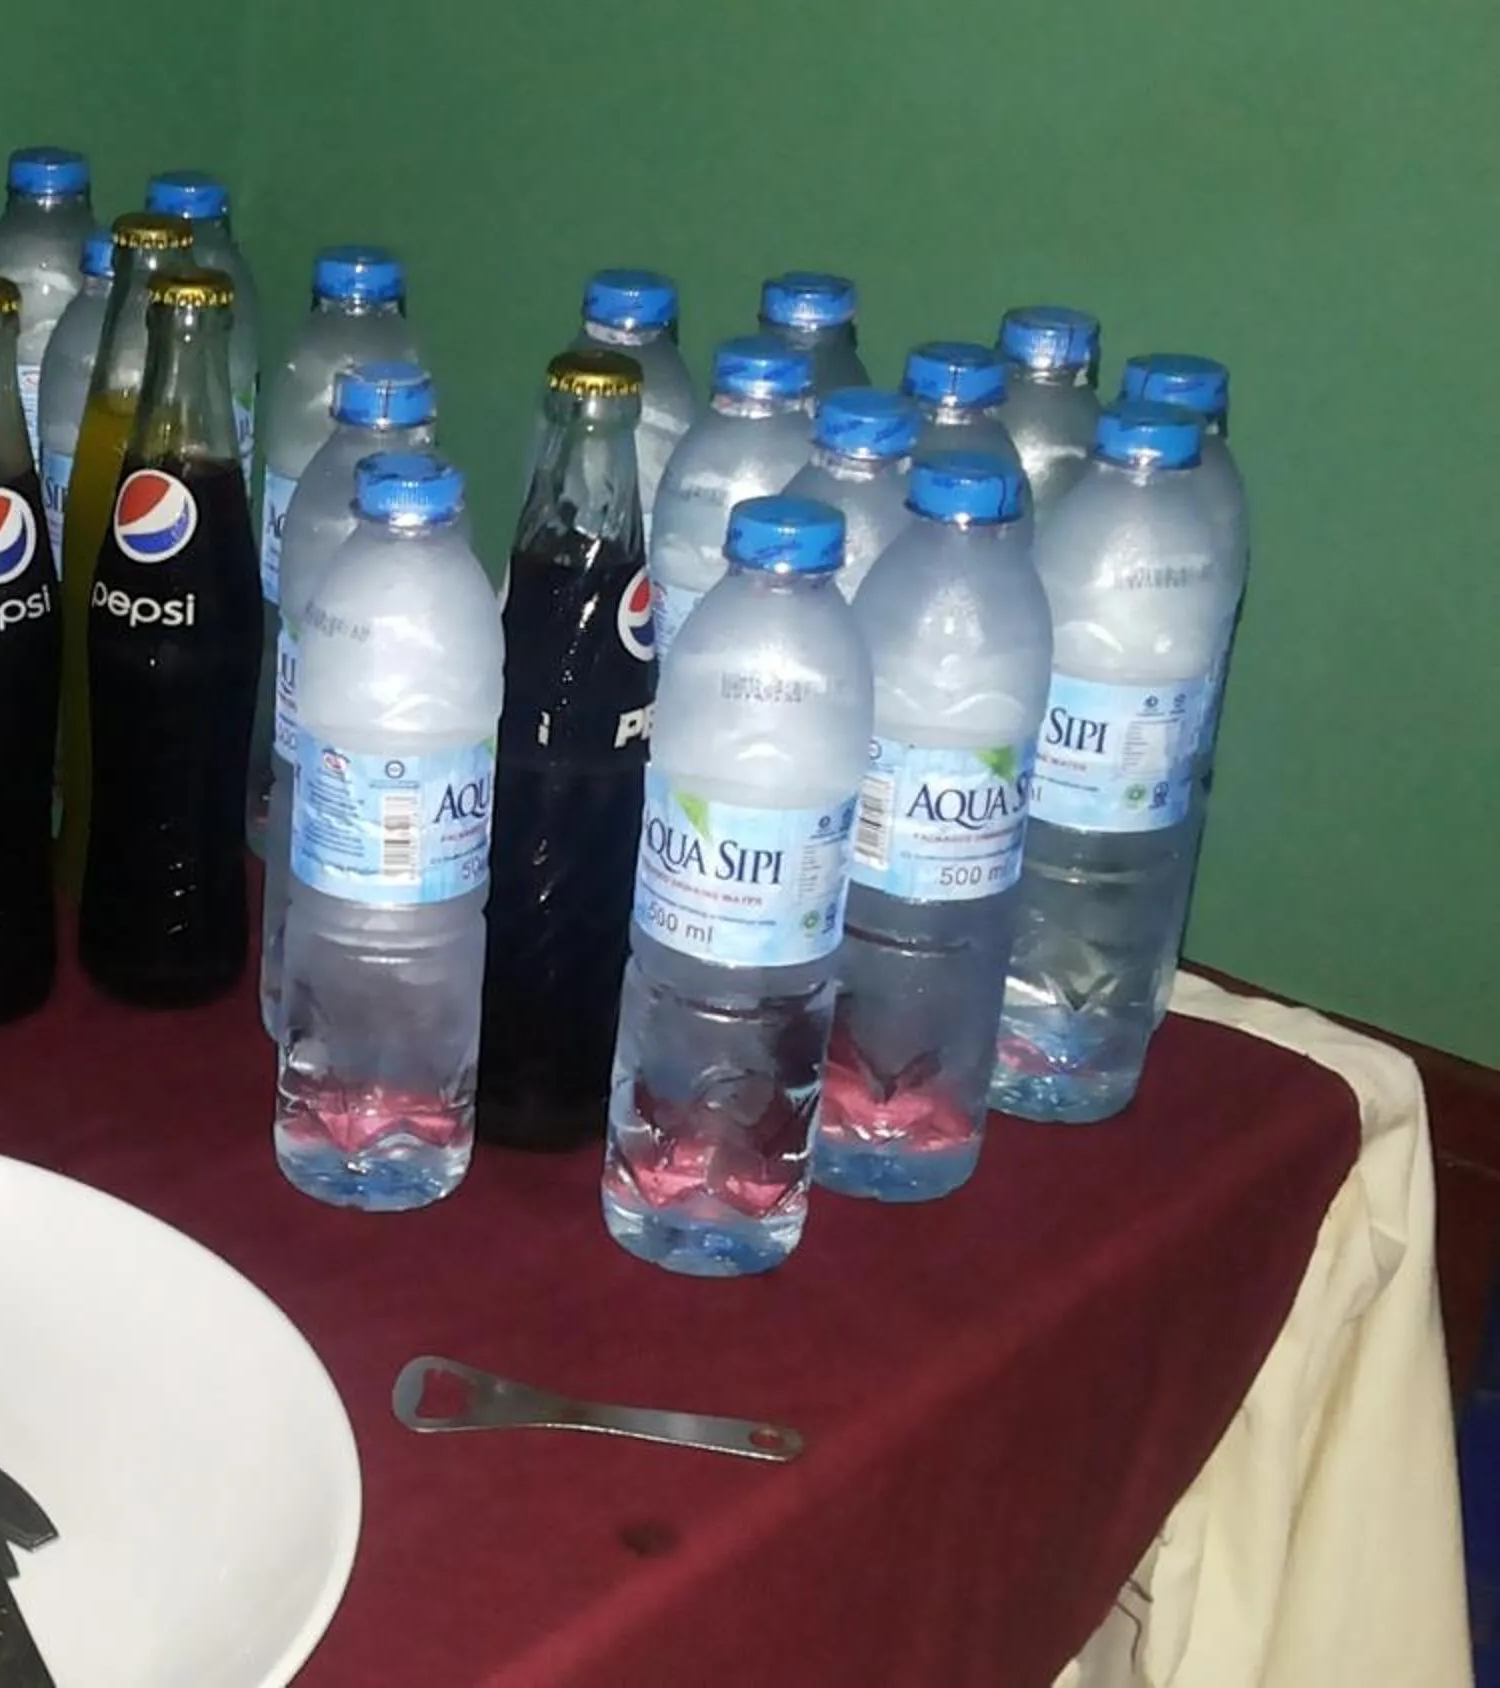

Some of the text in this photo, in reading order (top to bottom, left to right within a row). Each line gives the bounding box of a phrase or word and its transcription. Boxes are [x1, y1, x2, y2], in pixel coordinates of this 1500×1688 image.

[92, 581, 196, 628] pepsi
[1046, 706, 1108, 754] SIPI
[906, 783, 1008, 831] AQUA
[714, 839, 785, 885] SIPI
[939, 865, 983, 886] 500
[648, 900, 679, 932] 500
[685, 924, 714, 944] ml
